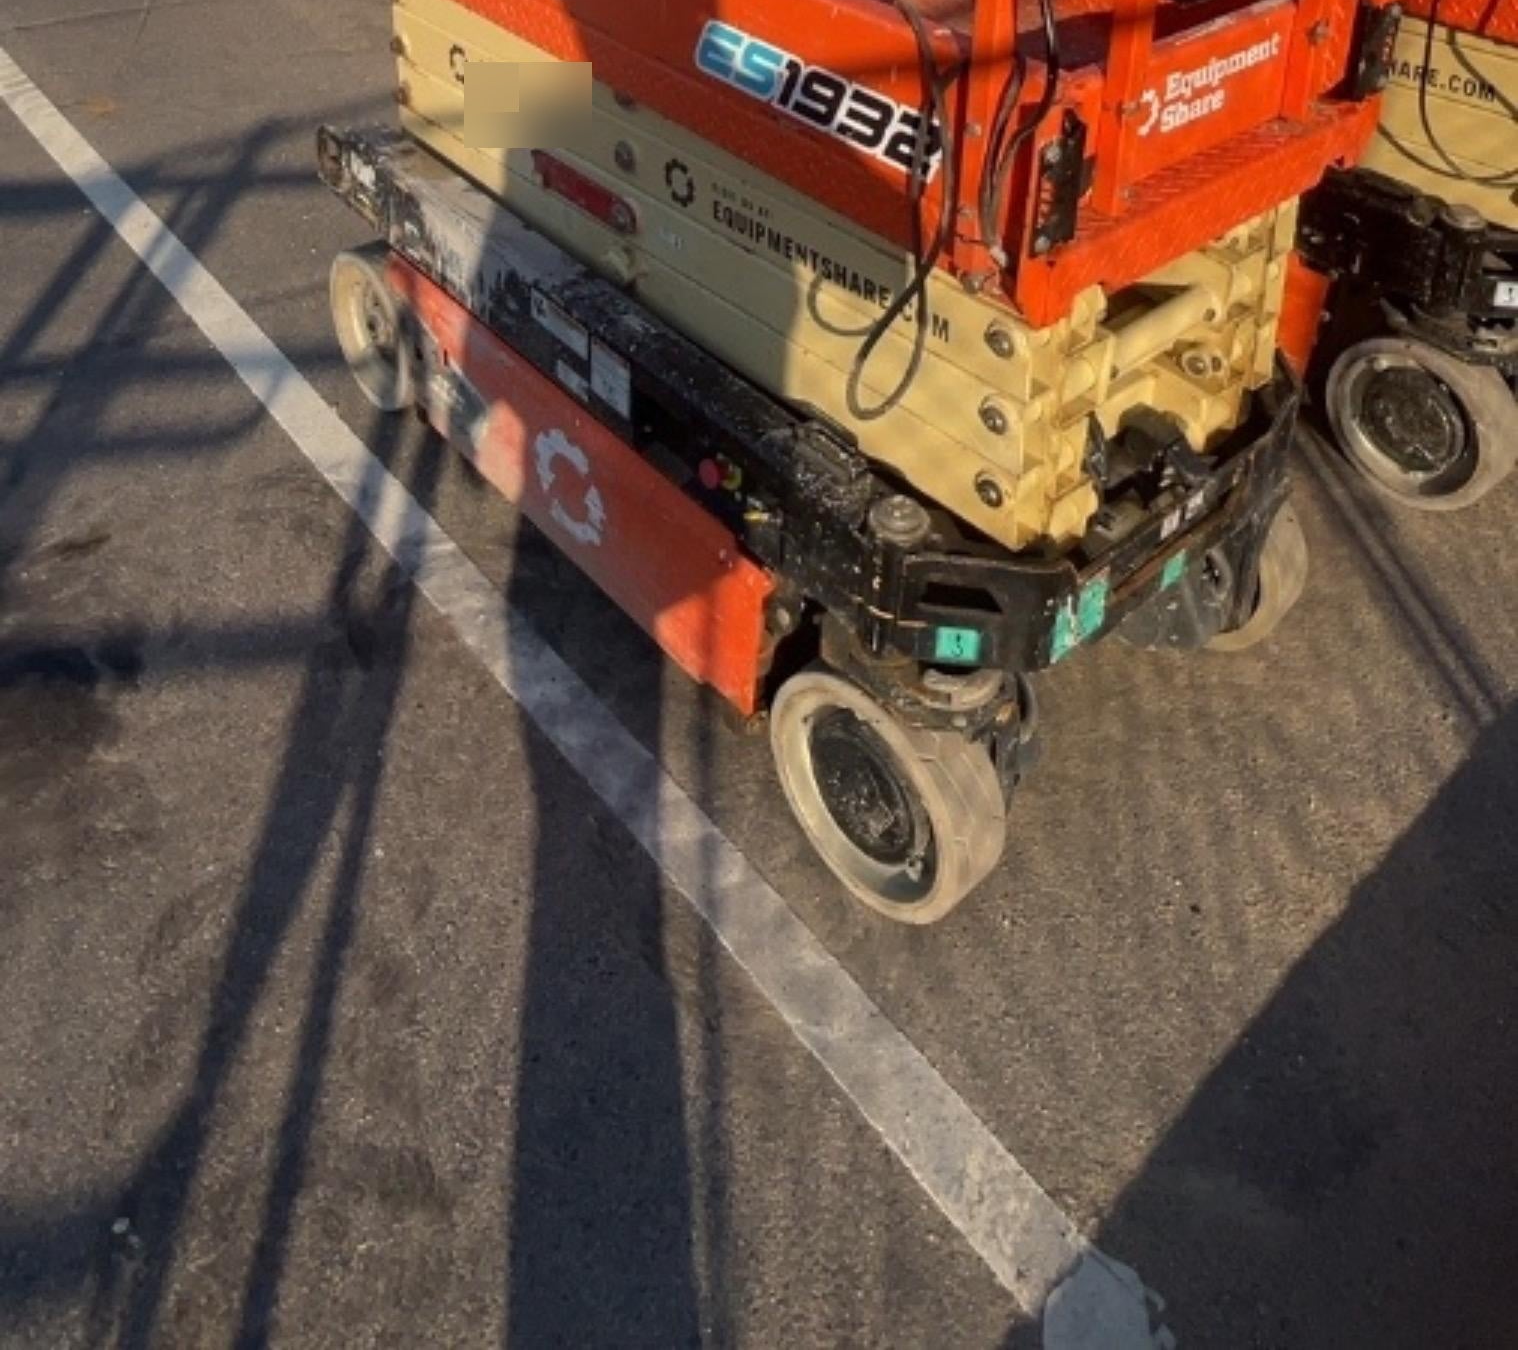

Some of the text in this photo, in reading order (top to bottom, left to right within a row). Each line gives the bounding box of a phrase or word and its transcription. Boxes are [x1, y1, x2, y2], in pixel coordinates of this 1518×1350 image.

[696, 21, 942, 181] ES1932
[1164, 31, 1281, 103] Equipment
[1160, 88, 1226, 133] Share
